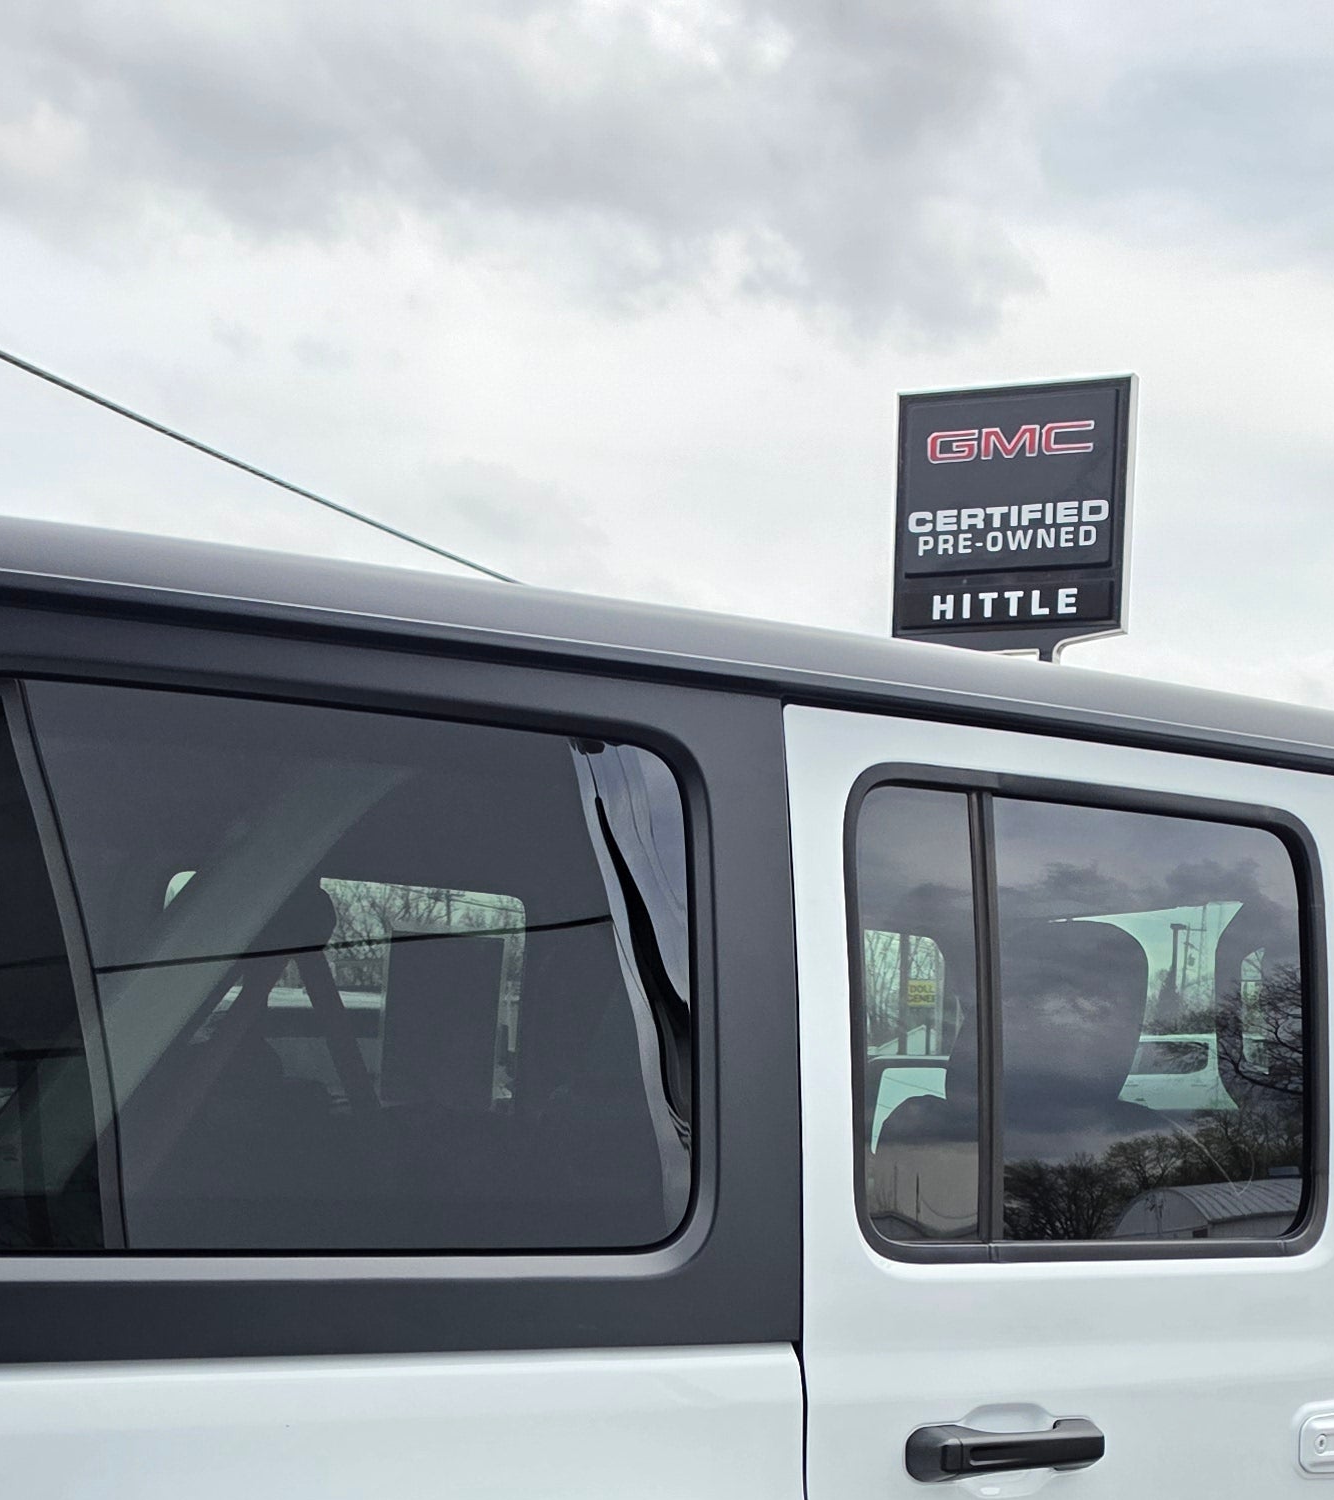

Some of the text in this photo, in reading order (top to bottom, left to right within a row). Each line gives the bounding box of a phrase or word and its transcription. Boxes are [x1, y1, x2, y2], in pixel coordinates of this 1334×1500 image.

[927, 420, 1095, 464] GMC
[908, 499, 1109, 533] CERTIFIED
[918, 525, 1097, 556] PRE-OWNED
[932, 588, 1078, 620] HITTLE
